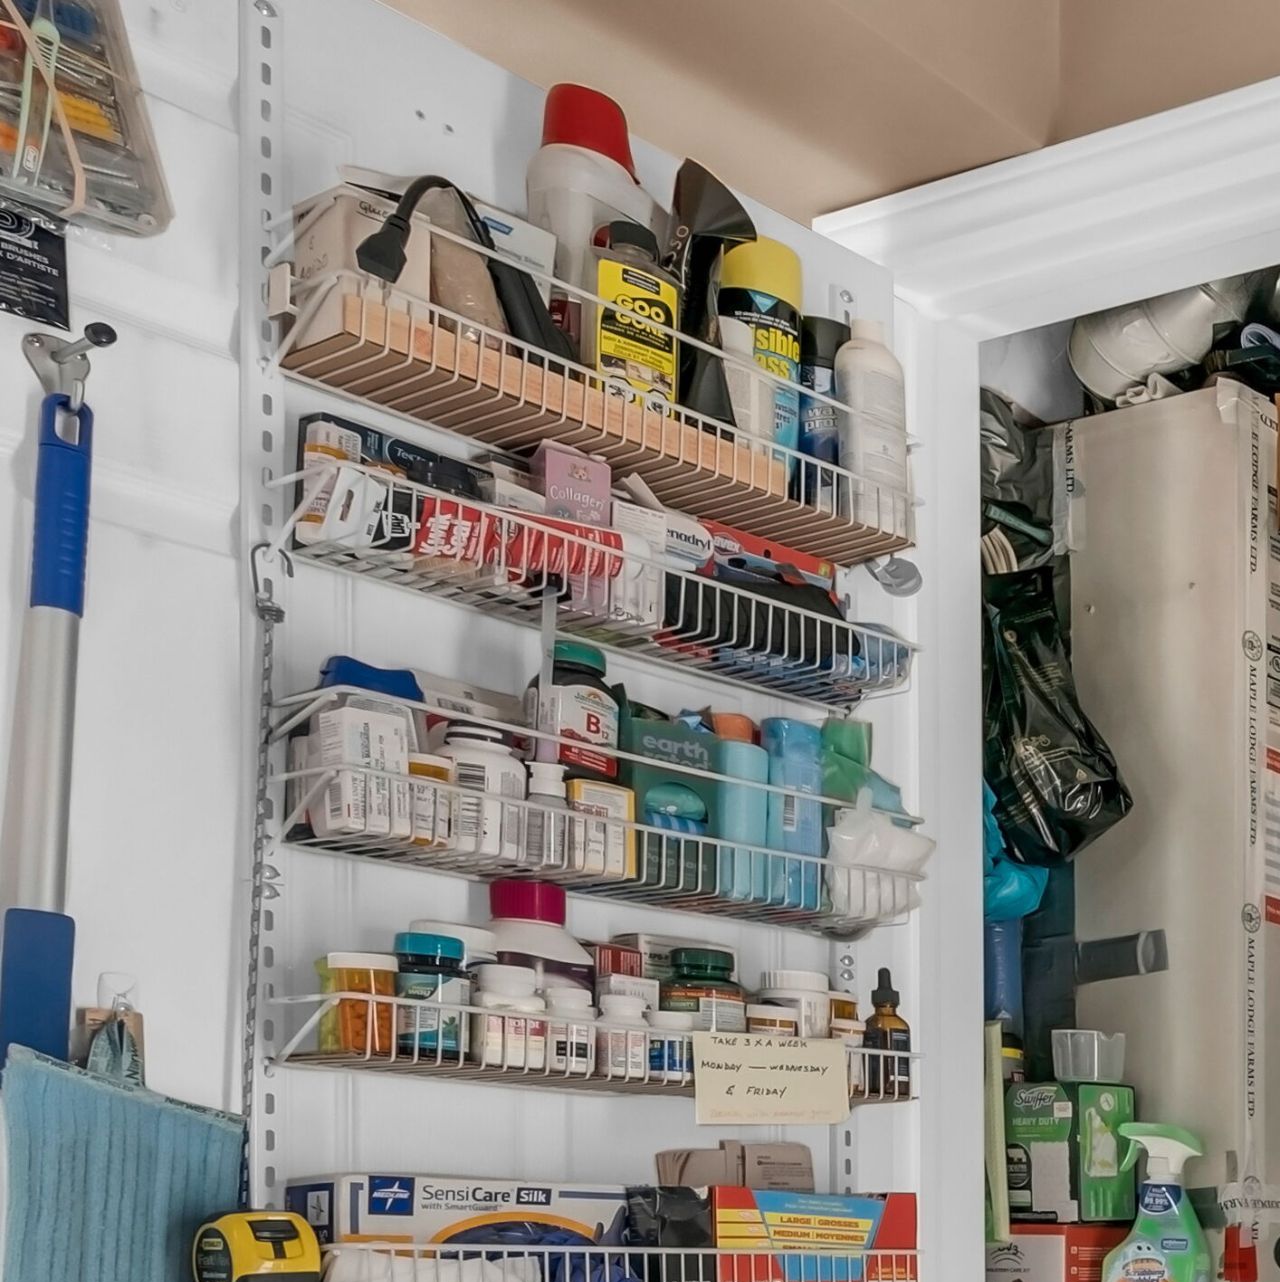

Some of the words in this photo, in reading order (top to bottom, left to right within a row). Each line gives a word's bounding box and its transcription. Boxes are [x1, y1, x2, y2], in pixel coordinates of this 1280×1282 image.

[615, 293, 666, 324] GOO
[549, 484, 606, 511] Collagen
[1249, 496, 1259, 541] FARMS
[665, 527, 711, 552] enadryl
[1249, 664, 1258, 711] MAPLE
[642, 733, 709, 760] earth
[1249, 716, 1258, 763] LODGE
[1249, 768, 1257, 820] FARMS
[1248, 937, 1257, 985] MAPLE
[1248, 989, 1257, 1037] LODGE
[710, 1036, 738, 1047] TAKE
[754, 1038, 763, 1047] X
[765, 1039, 773, 1047] A
[778, 1040, 808, 1048] WEEK
[701, 1060, 742, 1073] MONDAY
[770, 1064, 829, 1076] WEDNESDAY
[1247, 1041, 1257, 1088] FARMS
[746, 1086, 787, 1098] FRIDAY
[1013, 1086, 1057, 1110] Swiffer
[1012, 1117, 1036, 1126] HEAVY
[1038, 1117, 1060, 1126] DUTY
[422, 1184, 511, 1202] SensiCare
[519, 1189, 547, 1203] Silk
[421, 1202, 442, 1210] with
[445, 1203, 499, 1212] SmartGuard
[780, 1215, 812, 1225] LARGE
[818, 1218, 860, 1229] GROSSES
[773, 1229, 811, 1239] MEDIUM
[816, 1231, 866, 1242] MOYENNES
